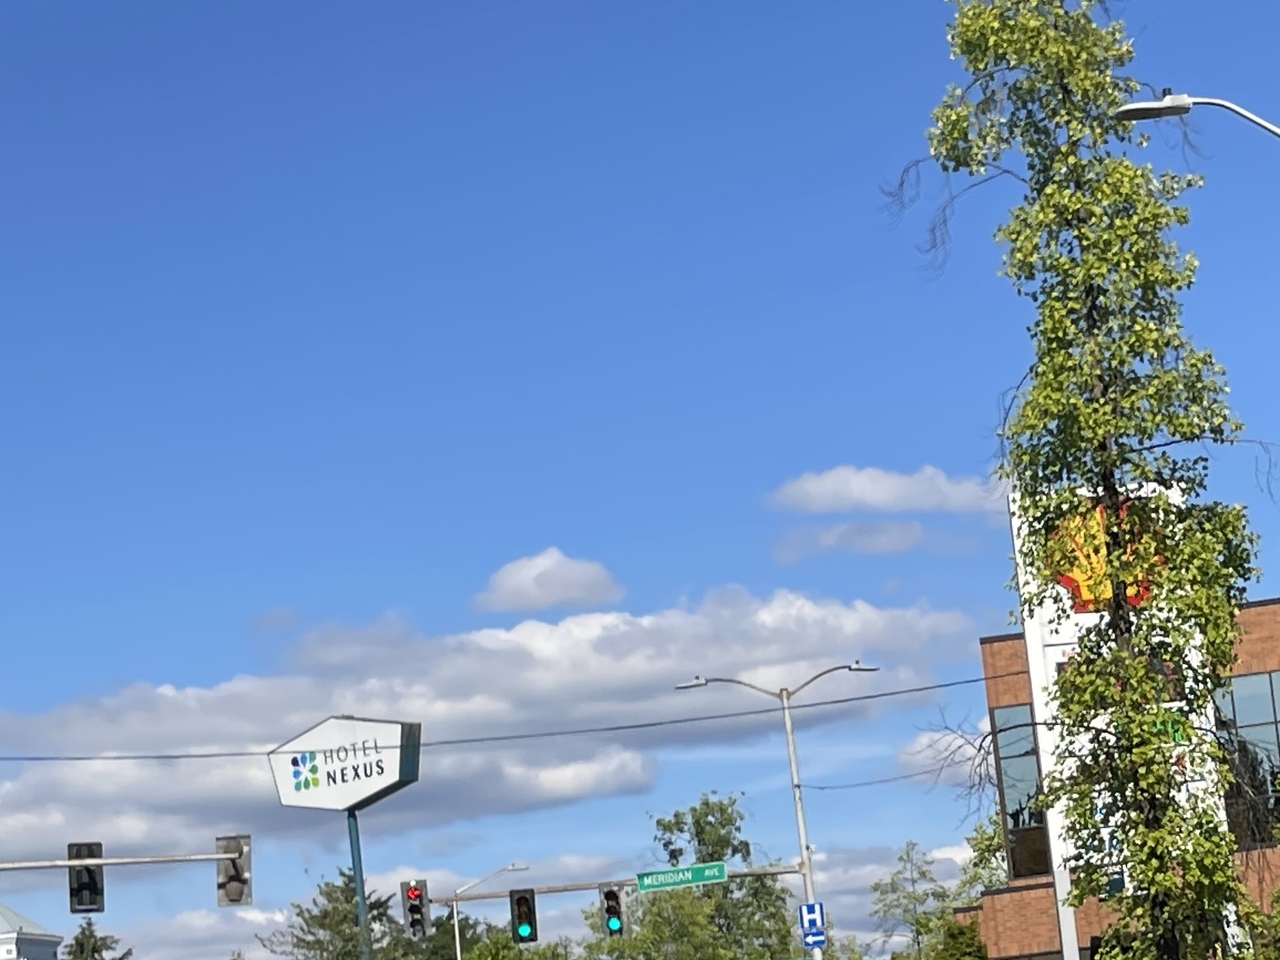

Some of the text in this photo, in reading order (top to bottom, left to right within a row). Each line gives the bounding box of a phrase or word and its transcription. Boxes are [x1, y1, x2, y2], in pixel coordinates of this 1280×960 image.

[323, 738, 383, 766] HOTEL
[326, 759, 385, 787] NEXUS
[643, 867, 720, 887] MERIDIAN AVE
[801, 903, 822, 929] H
